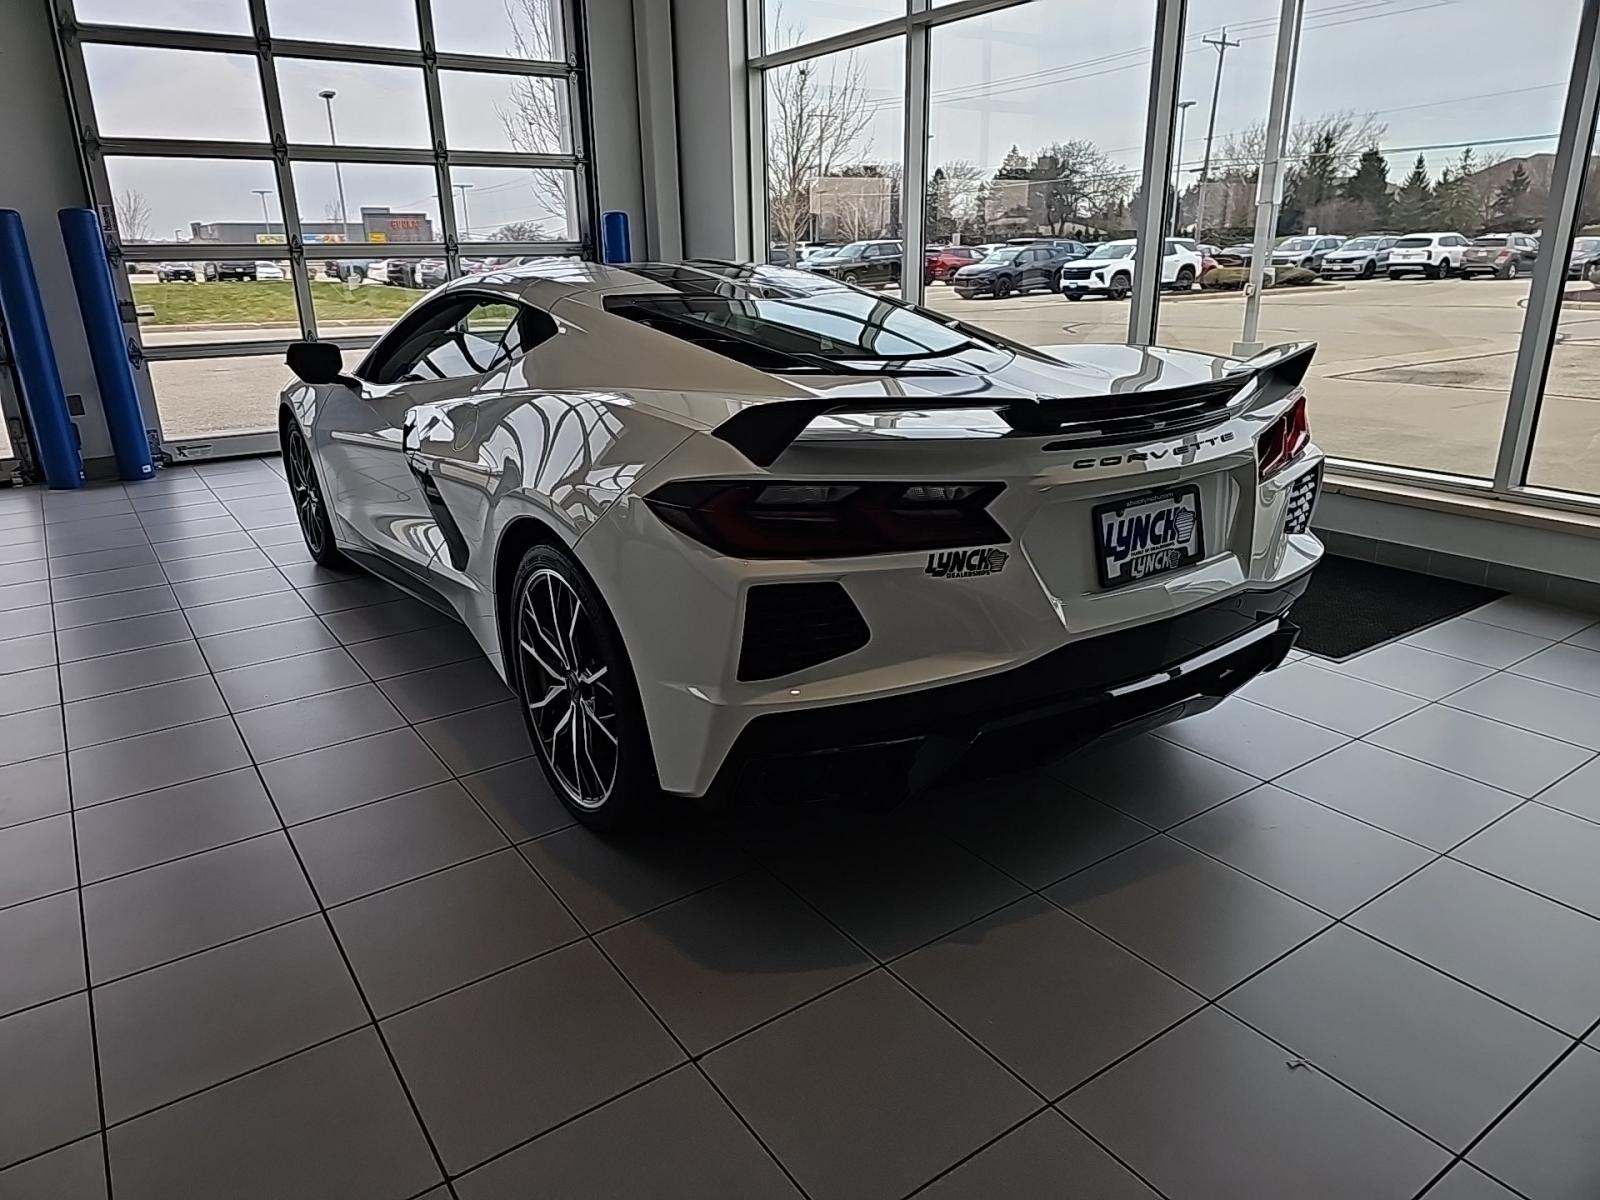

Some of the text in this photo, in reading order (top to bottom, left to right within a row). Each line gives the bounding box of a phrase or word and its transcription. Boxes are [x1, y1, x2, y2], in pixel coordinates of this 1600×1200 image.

[1073, 432, 1234, 469] CORVETTE
[1104, 508, 1179, 562] LYNCH
[925, 548, 993, 577] LYNCH
[946, 570, 990, 578] DEALERSHIPS
[1131, 551, 1170, 578] LYNCH
